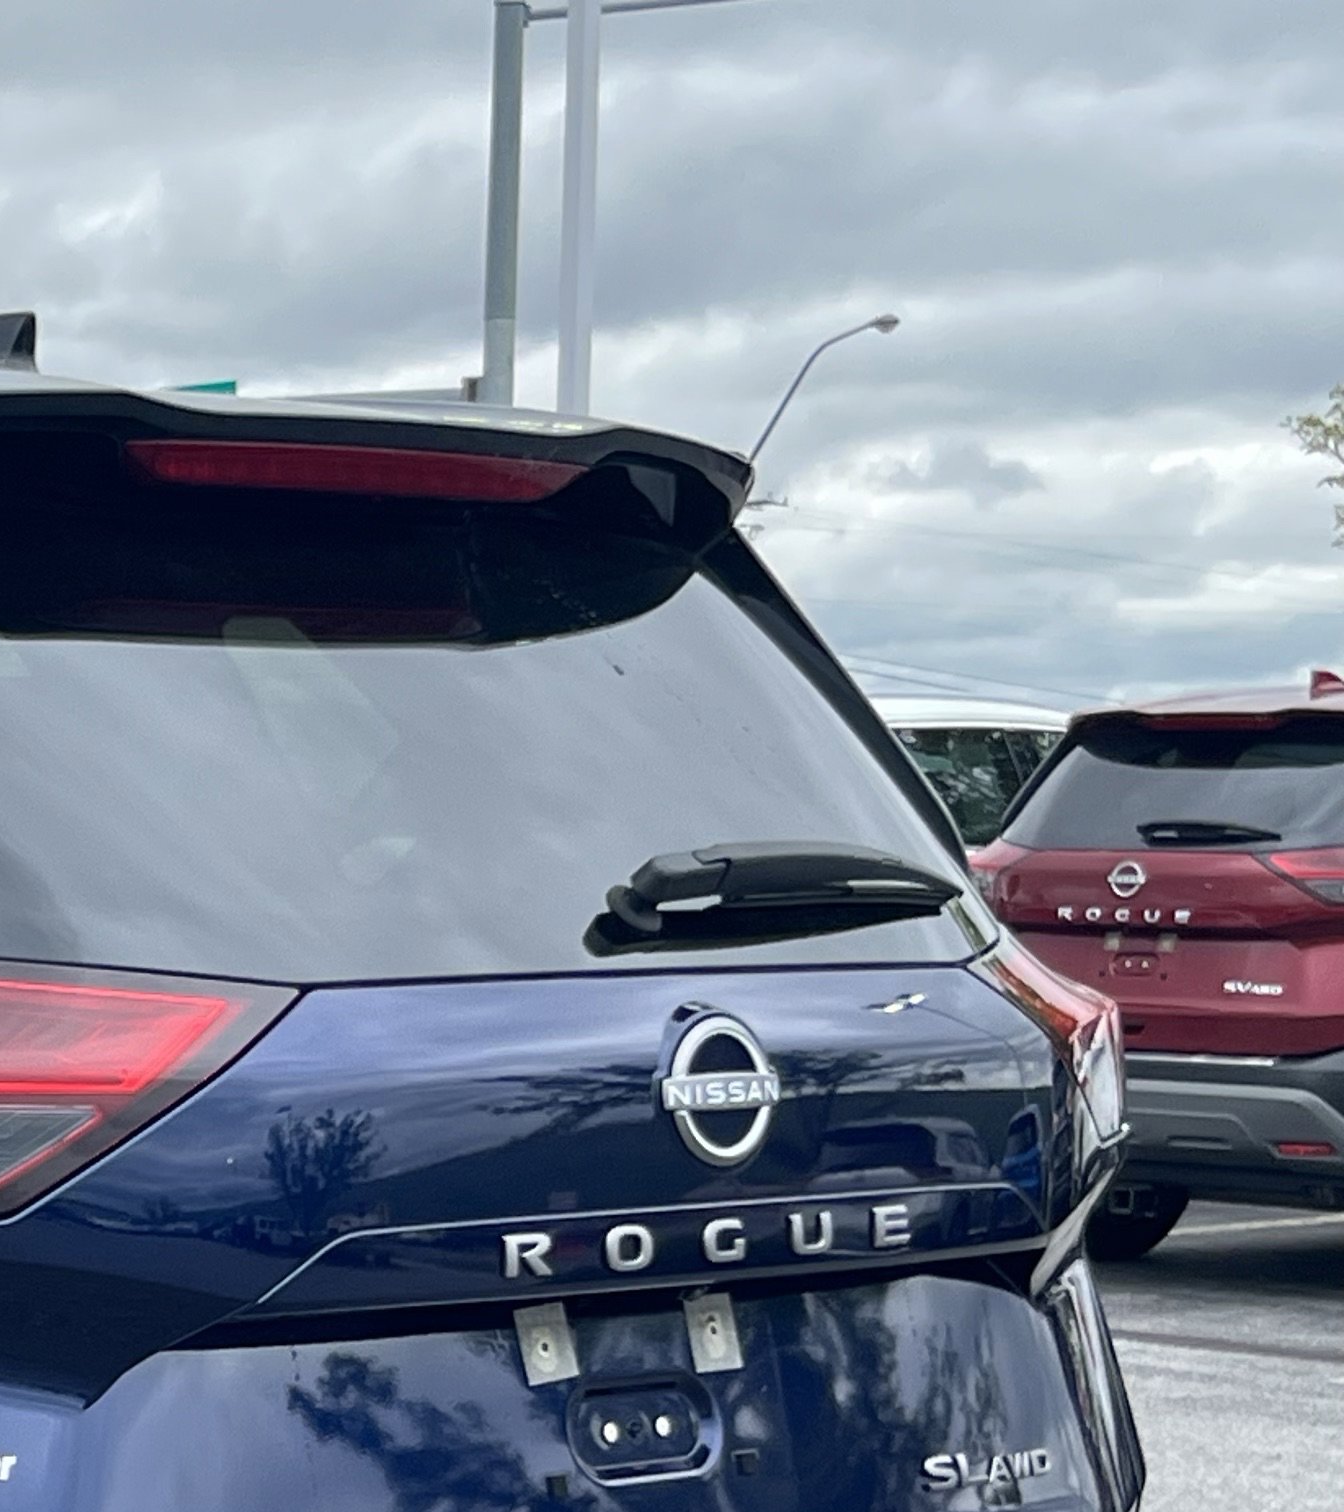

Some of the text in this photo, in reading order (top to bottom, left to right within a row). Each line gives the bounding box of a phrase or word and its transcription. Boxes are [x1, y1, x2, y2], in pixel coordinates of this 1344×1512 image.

[1058, 906, 1191, 924] ROGUE
[667, 1078, 780, 1106] NISSAN
[501, 1204, 911, 1279] ROGUE
